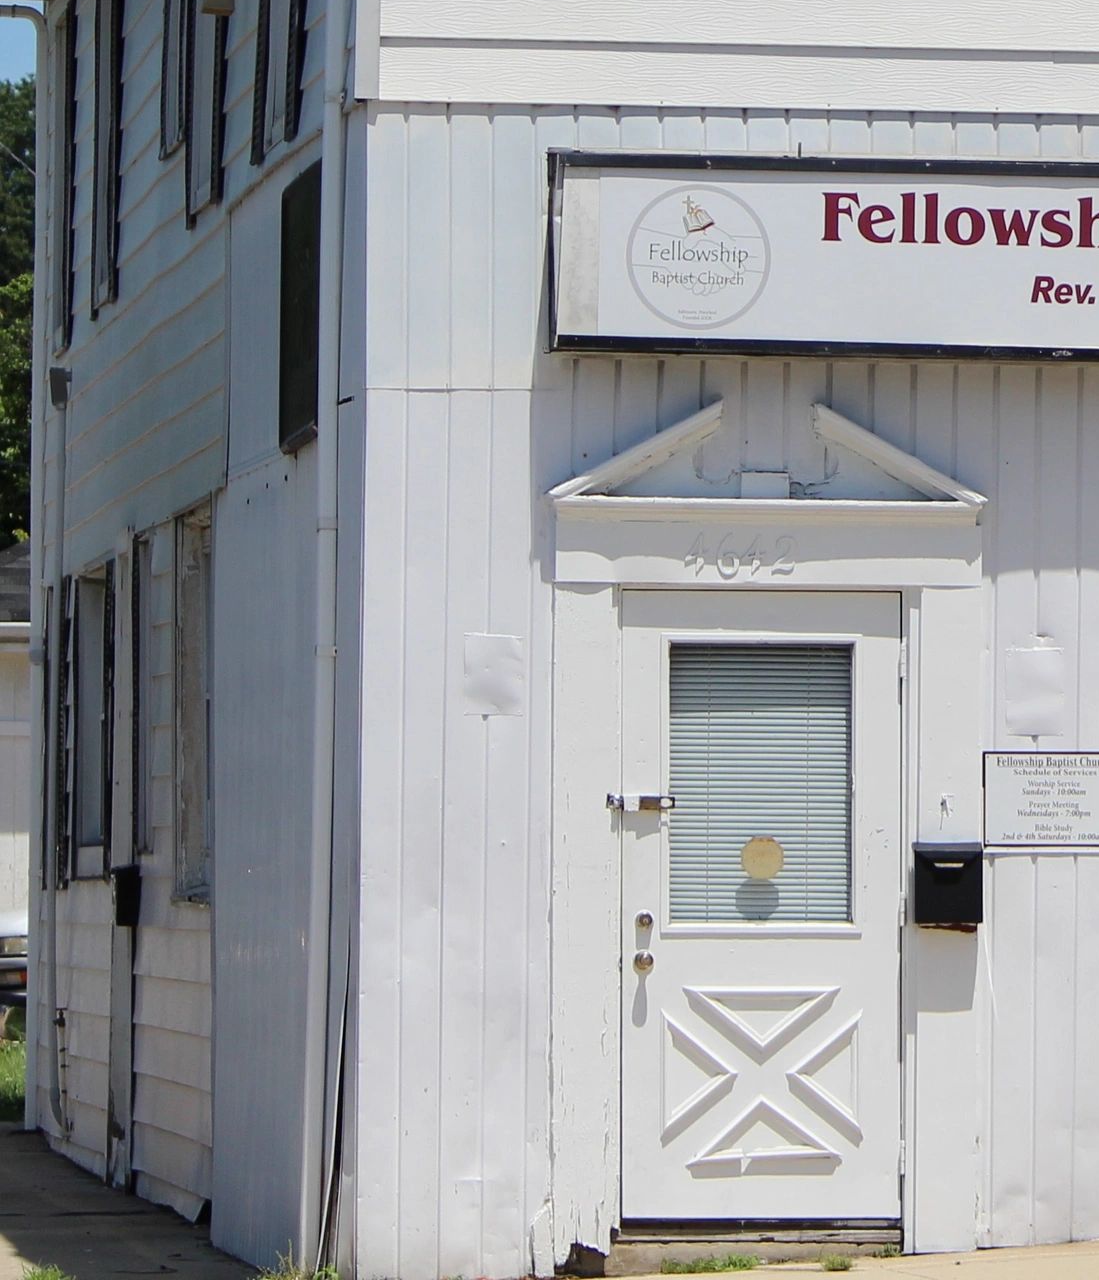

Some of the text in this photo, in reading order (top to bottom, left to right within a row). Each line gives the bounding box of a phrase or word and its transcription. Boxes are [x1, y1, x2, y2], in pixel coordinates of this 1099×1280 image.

[649, 240, 749, 268] Fellowship
[652, 271, 744, 287] Baptist Church
[1031, 275, 1096, 305] Rev.
[684, 531, 798, 580] 4642
[996, 756, 1044, 768] Fellowship
[1046, 757, 1077, 768] Baptist
[1028, 780, 1055, 789] Worship
[1022, 788, 1051, 797] Sundays
[1028, 801, 1080, 809] Prayer Meeting
[1016, 809, 1059, 818] Wednesdays
[1065, 809, 1091, 819] 7:00pm
[1034, 824, 1073, 833] Bible Study
[1037, 833, 1071, 841] Saturdays
